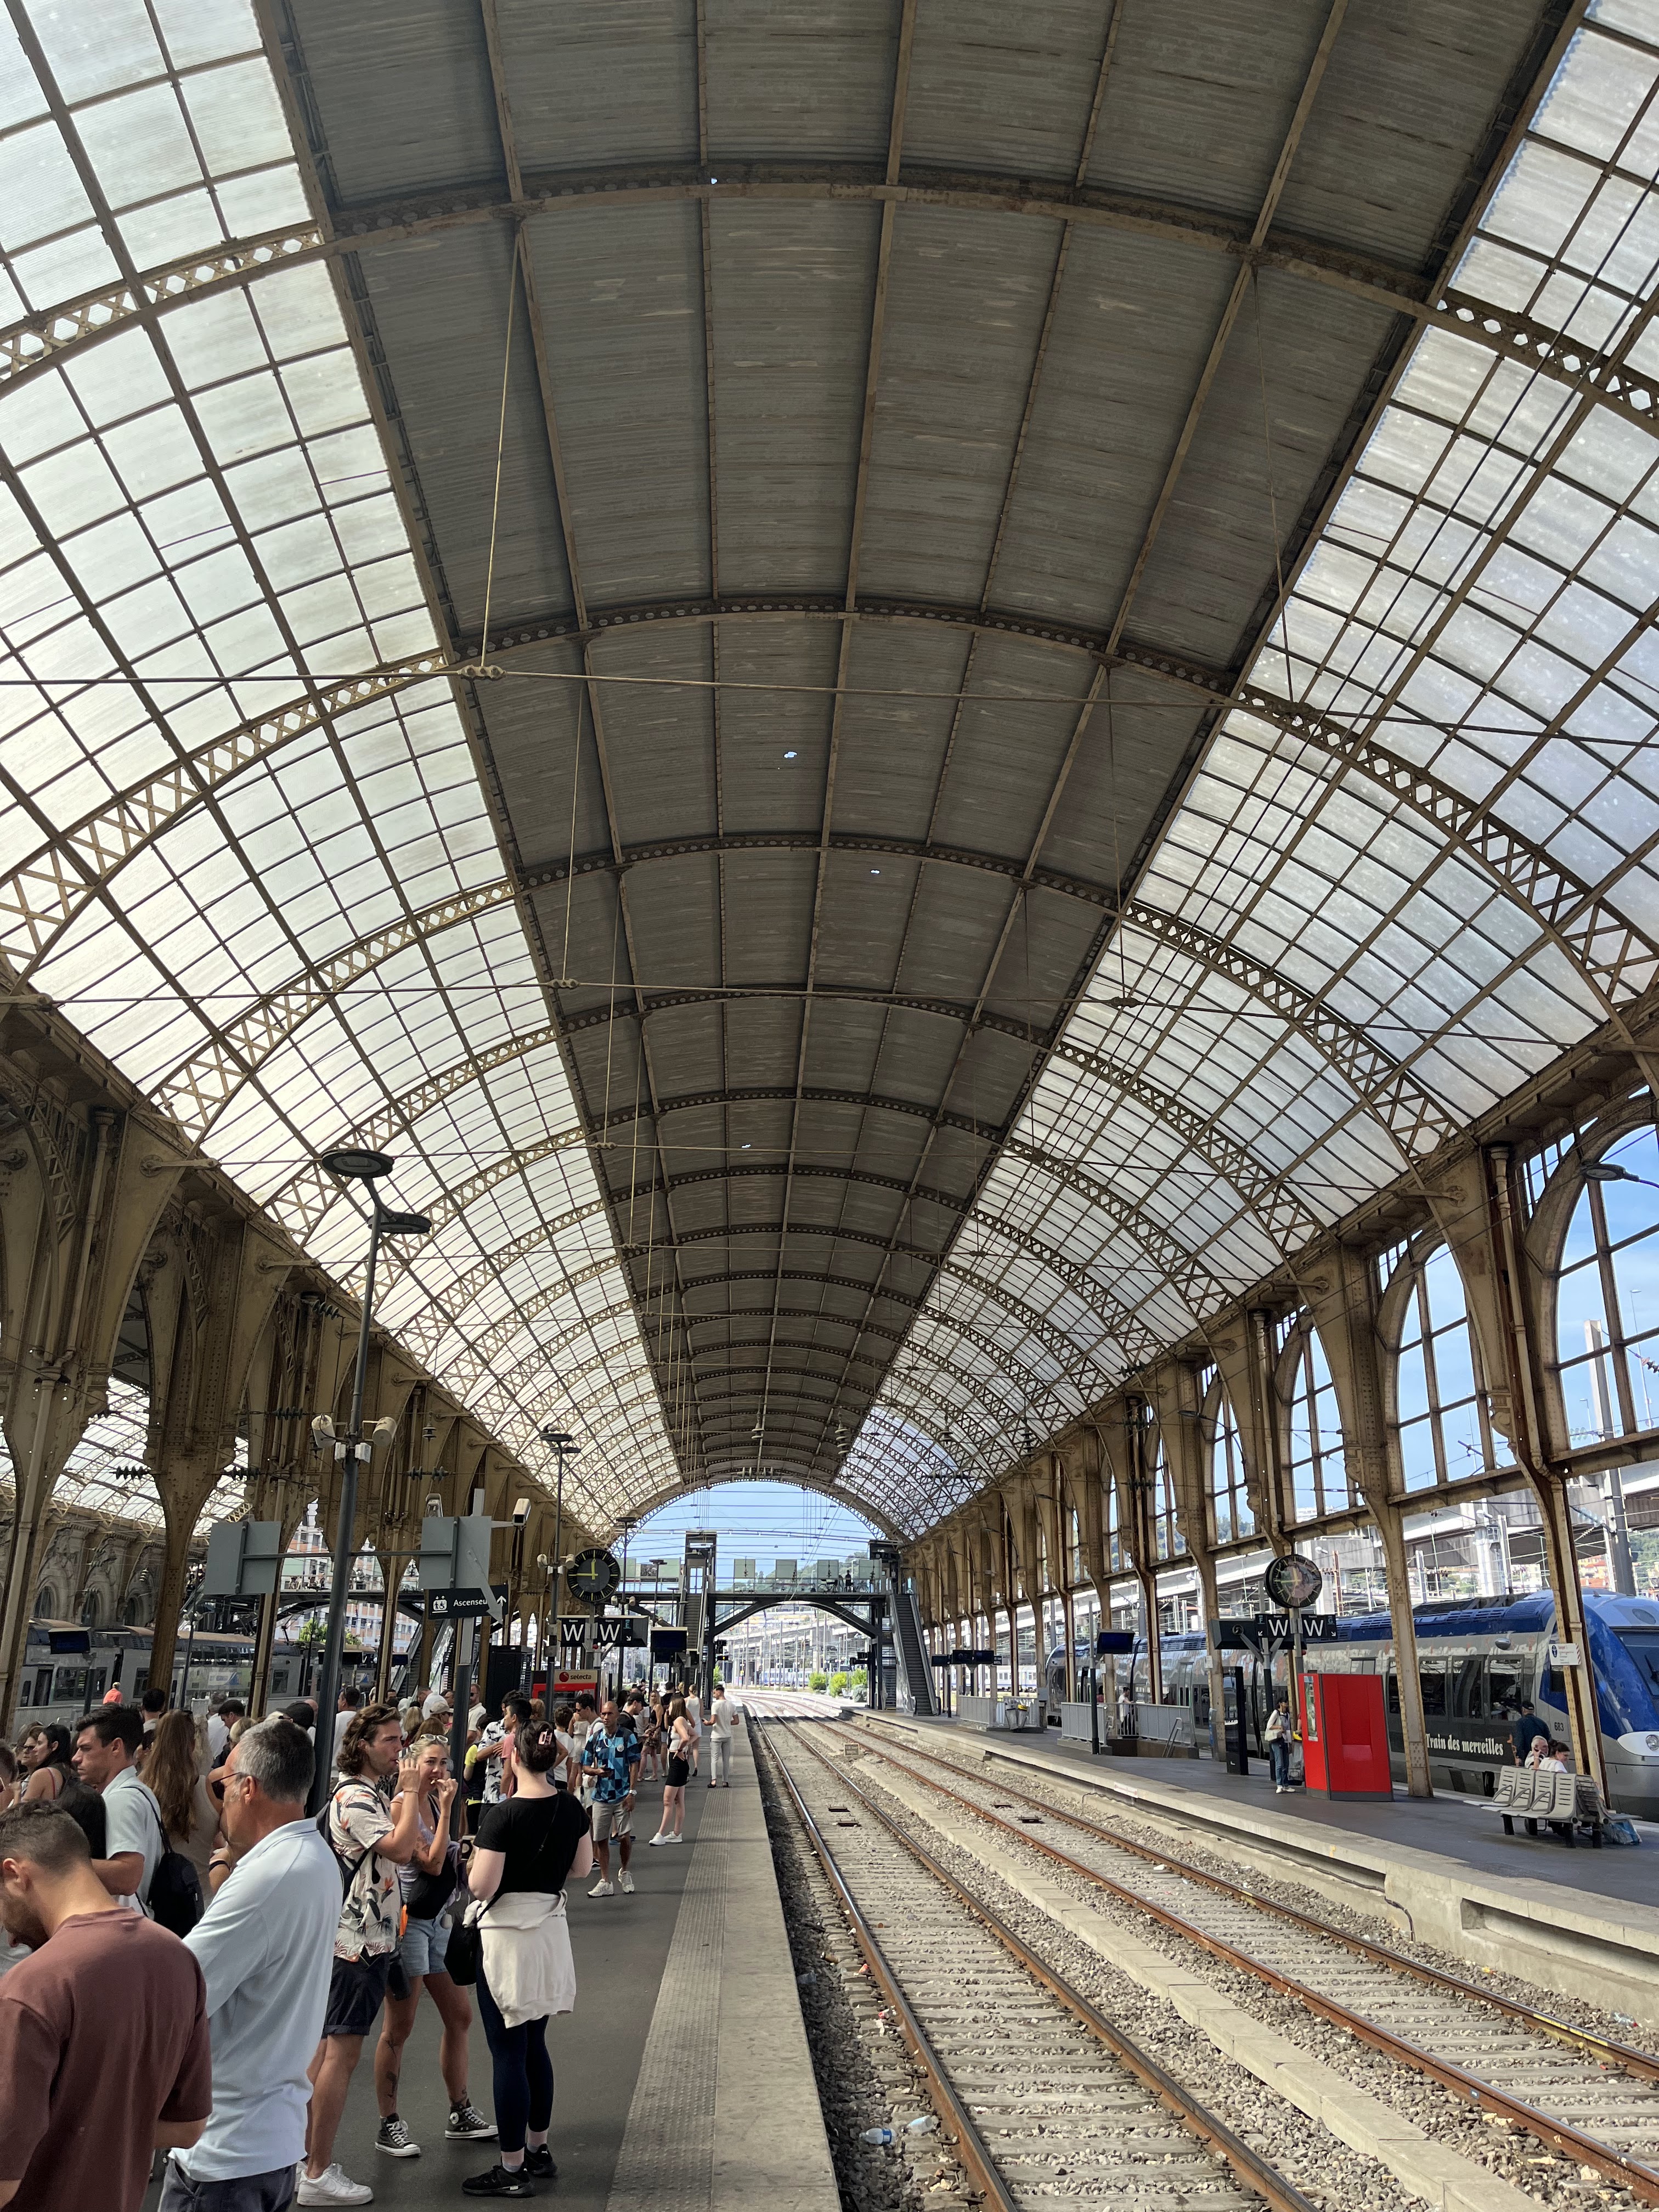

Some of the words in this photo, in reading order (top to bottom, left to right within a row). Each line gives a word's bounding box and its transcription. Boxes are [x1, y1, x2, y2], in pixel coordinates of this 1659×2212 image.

[563, 1624, 584, 1641] W
[600, 1624, 620, 1641] W
[1268, 1620, 1288, 1636] W
[1304, 1620, 1324, 1637] W
[1555, 1722, 1564, 1731] 683
[1426, 1734, 1446, 1750] Train
[1448, 1734, 1460, 1751] des
[1462, 1738, 1503, 1756] merveilles
